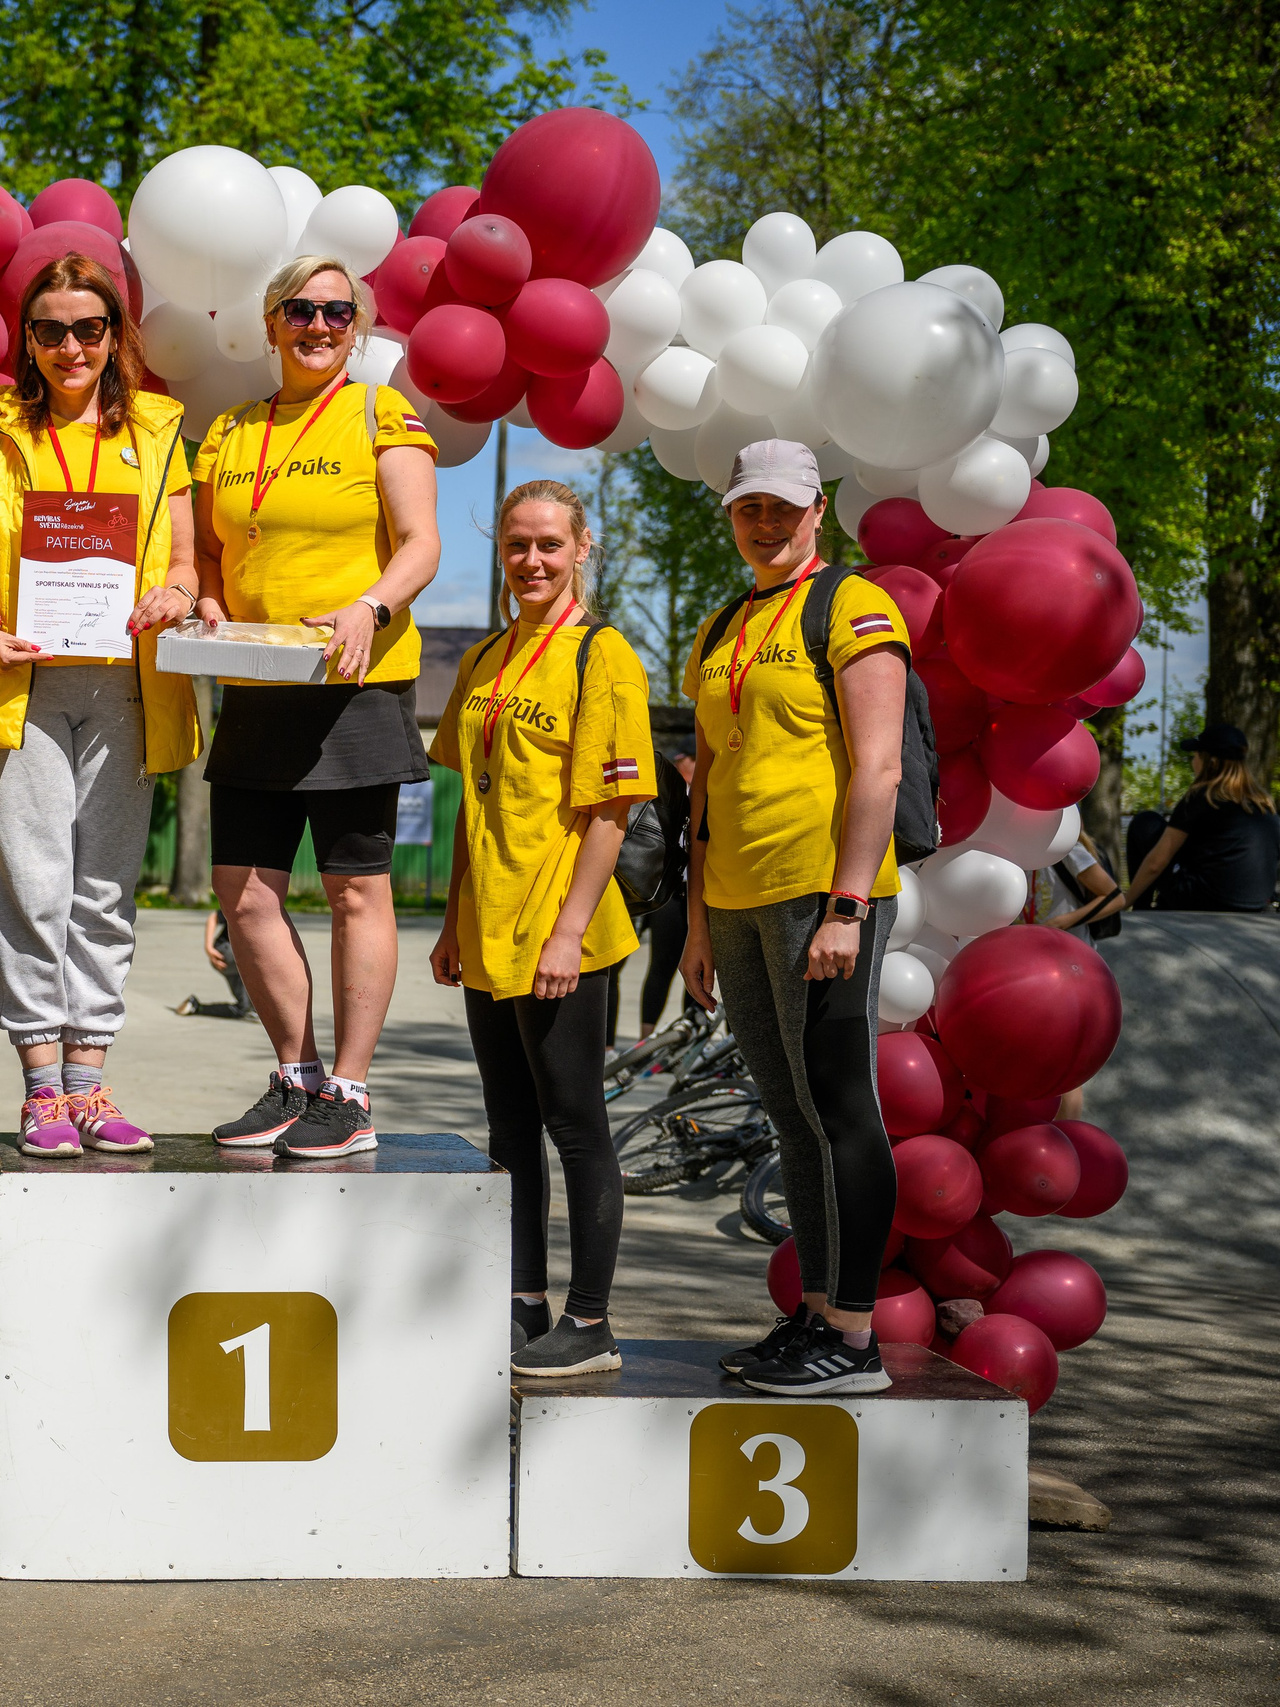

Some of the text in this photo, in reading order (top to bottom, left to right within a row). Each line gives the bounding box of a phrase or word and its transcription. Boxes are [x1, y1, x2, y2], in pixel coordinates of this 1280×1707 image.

[286, 456, 341, 477] Pūks
[46, 535, 113, 550] PATEICĪBA
[103, 582, 119, 590] PŪKS
[501, 696, 557, 732] Pūks
[294, 1066, 318, 1075] PUMA
[350, 1084, 365, 1095] PUM
[218, 1322, 271, 1432] 1
[737, 1433, 810, 1545] 3
